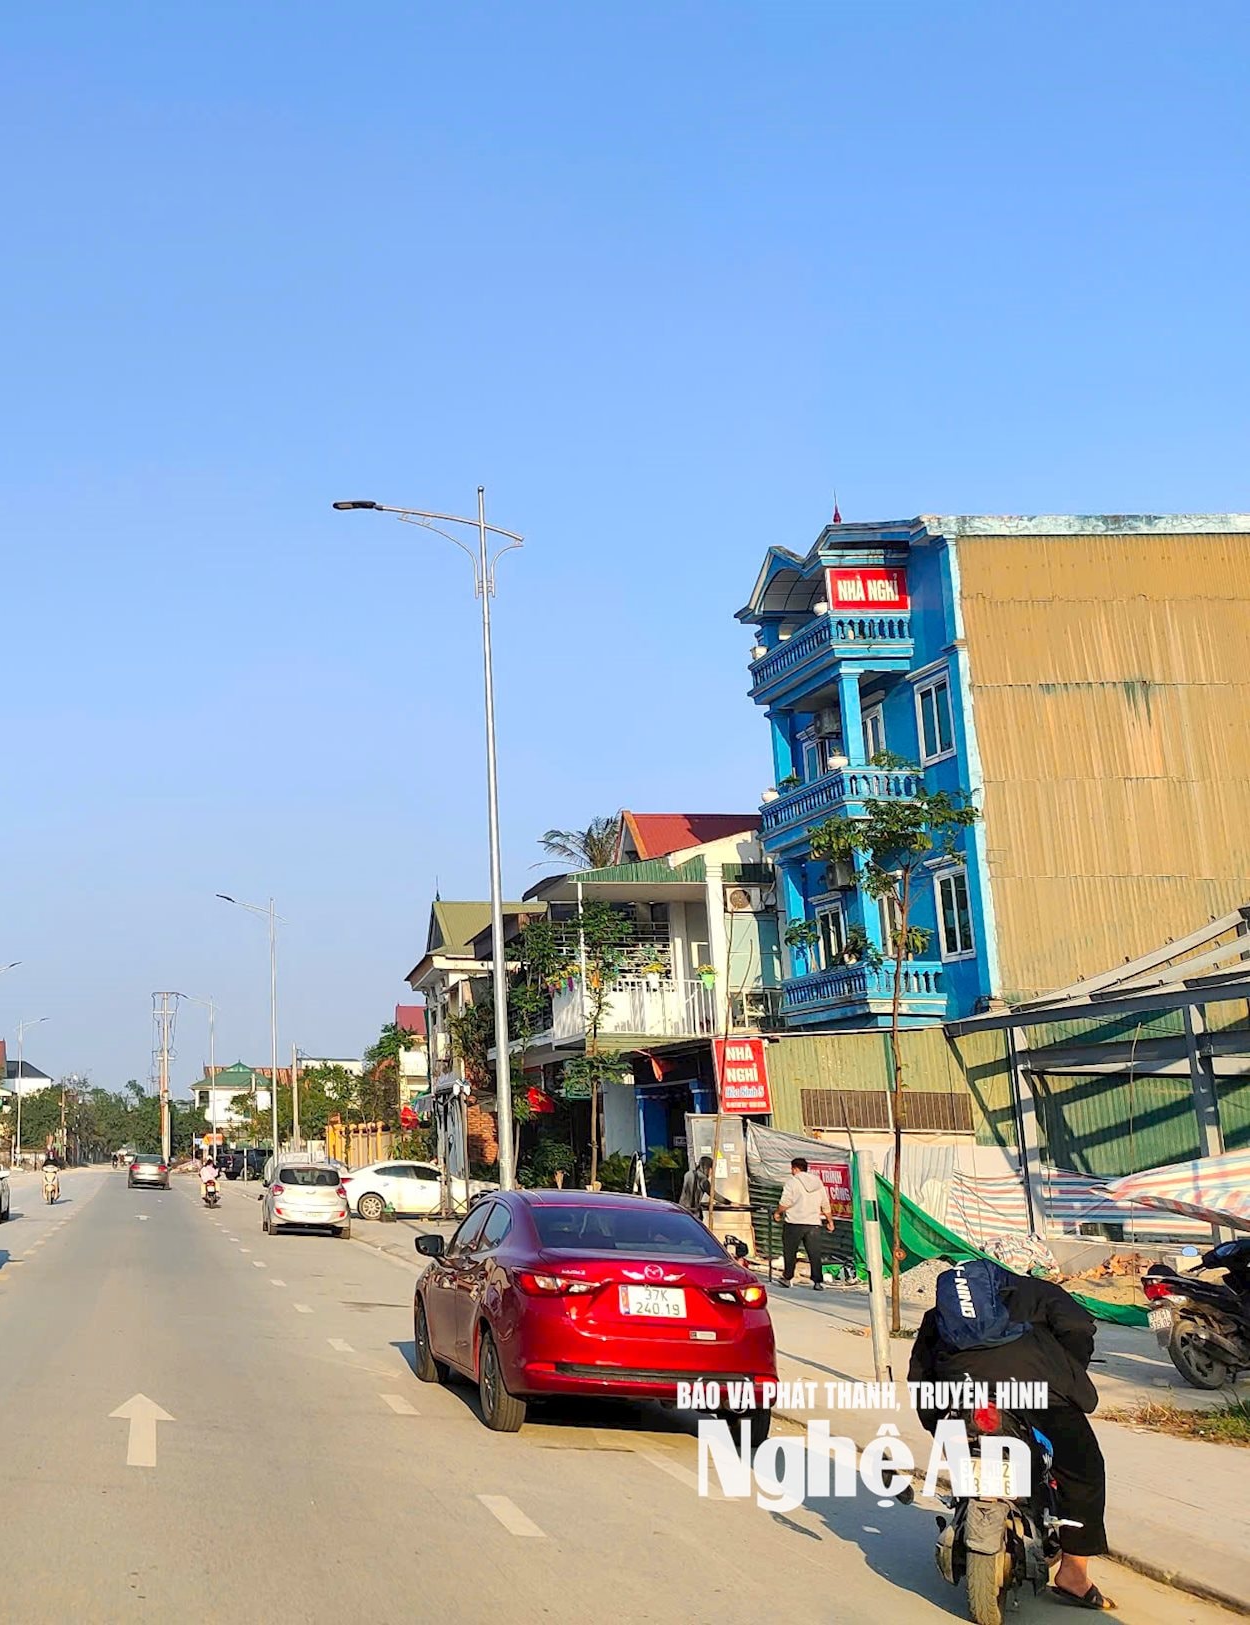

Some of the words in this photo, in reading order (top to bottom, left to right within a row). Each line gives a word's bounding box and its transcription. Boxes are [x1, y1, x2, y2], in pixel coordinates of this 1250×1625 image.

[837, 575, 866, 601] NHÀ
[867, 573, 899, 601] NGHỈ
[725, 1044, 754, 1061] NHÀ
[726, 1063, 759, 1082] NGHỈ
[644, 1287, 668, 1301] 37K
[636, 1302, 680, 1316] 240.19
